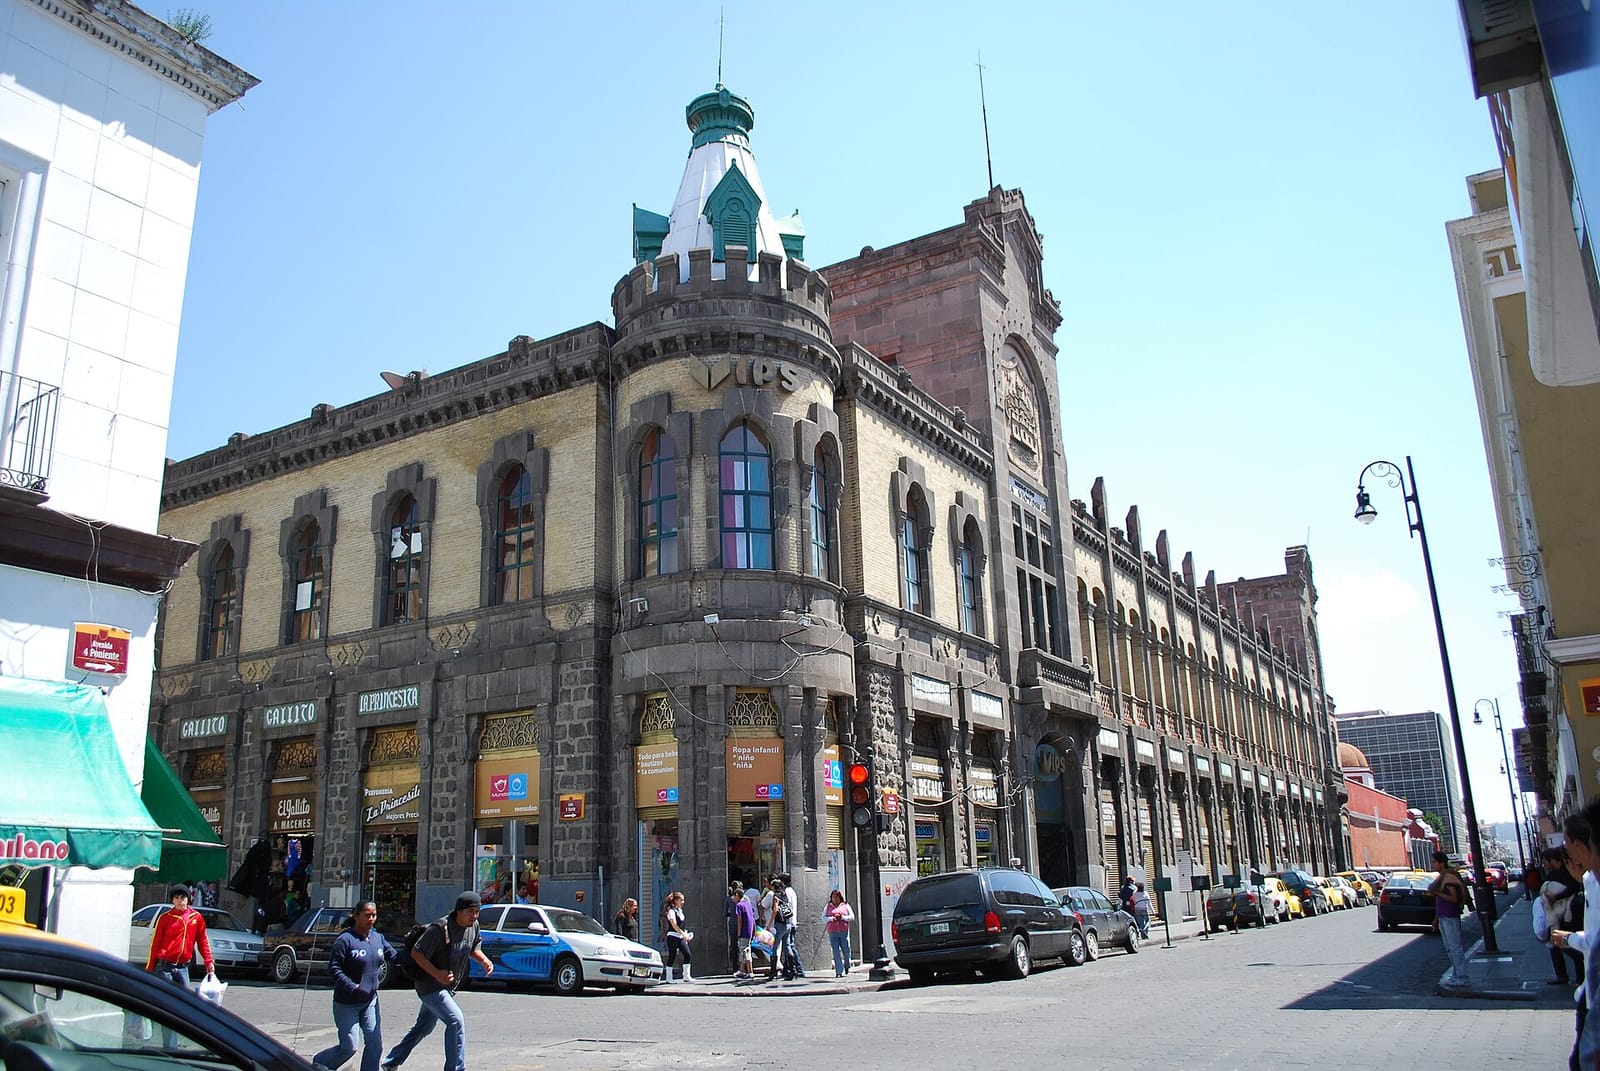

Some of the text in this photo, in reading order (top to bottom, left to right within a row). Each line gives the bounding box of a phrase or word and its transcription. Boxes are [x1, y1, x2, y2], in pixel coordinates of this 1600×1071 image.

[83, 648, 120, 661] 4 Poniente
[266, 702, 315, 726] GALLITO
[182, 716, 225, 737] GALLITO
[732, 746, 751, 755] Ropa
